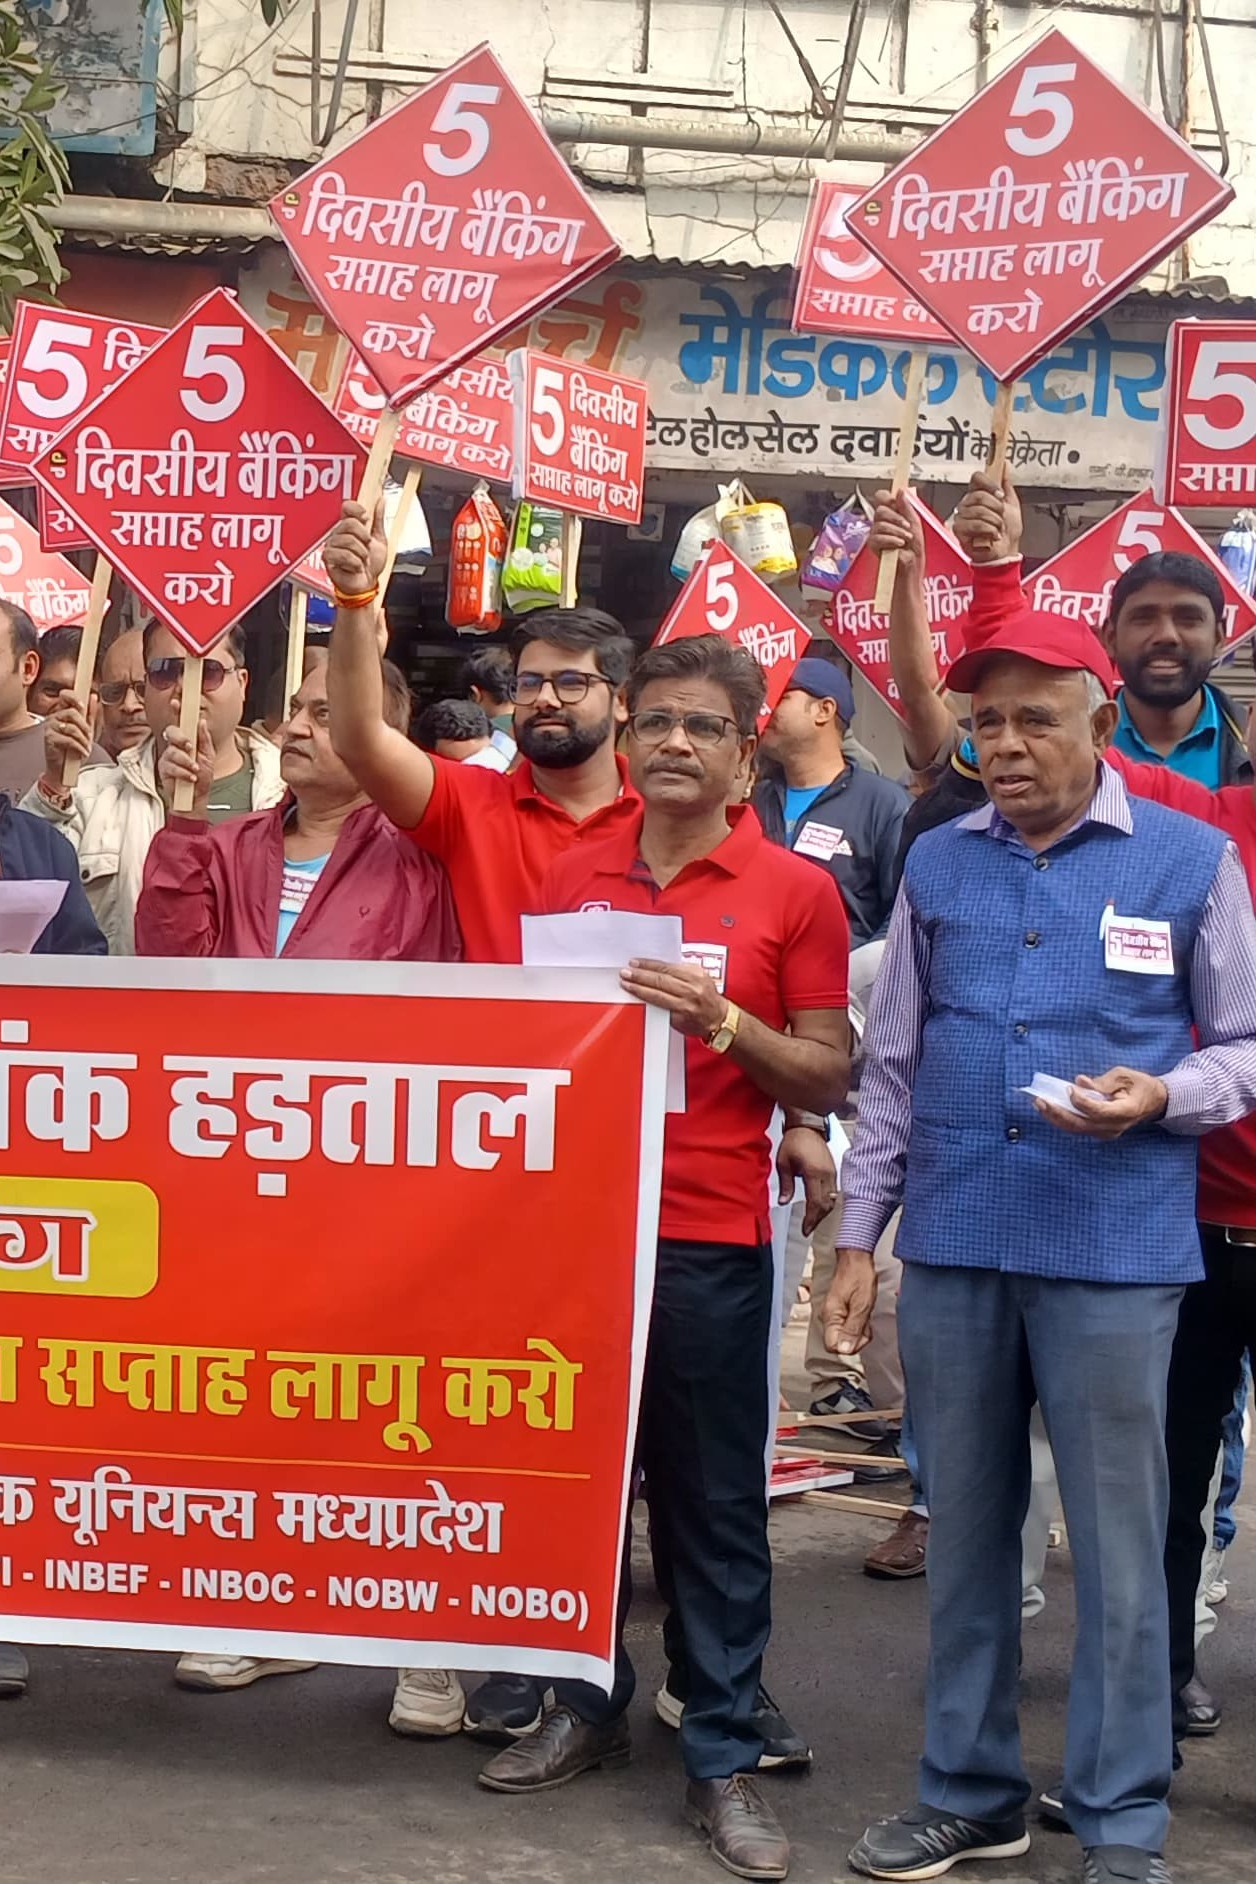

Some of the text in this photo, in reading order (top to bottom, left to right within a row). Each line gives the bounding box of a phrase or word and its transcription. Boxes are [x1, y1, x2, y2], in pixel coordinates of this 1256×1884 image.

[422, 82, 502, 177] 5
[1004, 63, 1077, 157] 5
[302, 170, 586, 266] दिवसीय बैंकिंग
[888, 155, 1189, 241] दिवसीय बैंकिंग
[813, 192, 884, 282] 5
[918, 237, 1106, 289] सप्ताह लागू
[324, 253, 499, 325] सप्ताह लागू
[810, 287, 898, 322] सप्ताह
[966, 288, 1043, 336] करो
[17, 319, 93, 418] 5
[179, 325, 246, 423] 5
[362, 312, 437, 361] करो
[531, 366, 565, 457] 5
[569, 373, 639, 429] दिवसीय
[1183, 340, 1256, 451] 5
[75, 425, 231, 499] दिवसीय
[238, 430, 357, 500] बैंकिंग
[405, 427, 459, 466] लागू
[461, 443, 512, 471] करो
[569, 424, 629, 481] बैंकिंग
[1179, 462, 1256, 492] सप्ता
[530, 462, 639, 514] सप्ताह लागू करो
[110, 511, 204, 551] सप्ताह
[211, 512, 291, 564] लागू
[164, 561, 234, 606] करो
[706, 560, 739, 631] 5
[162, 1054, 572, 1197] हड़ताल
[37, 1336, 255, 1415] सप्ताह
[266, 1348, 433, 1454] लागू
[442, 1337, 582, 1432] करो
[49, 1465, 257, 1546] यूनियन्स
[274, 1479, 504, 1554] मध्यप्रदेश
[44, 1557, 149, 1595] INBEF
[181, 1568, 294, 1605] INBOC
[328, 1575, 439, 1612] NOBW
[470, 1584, 589, 1632] NOBO)
